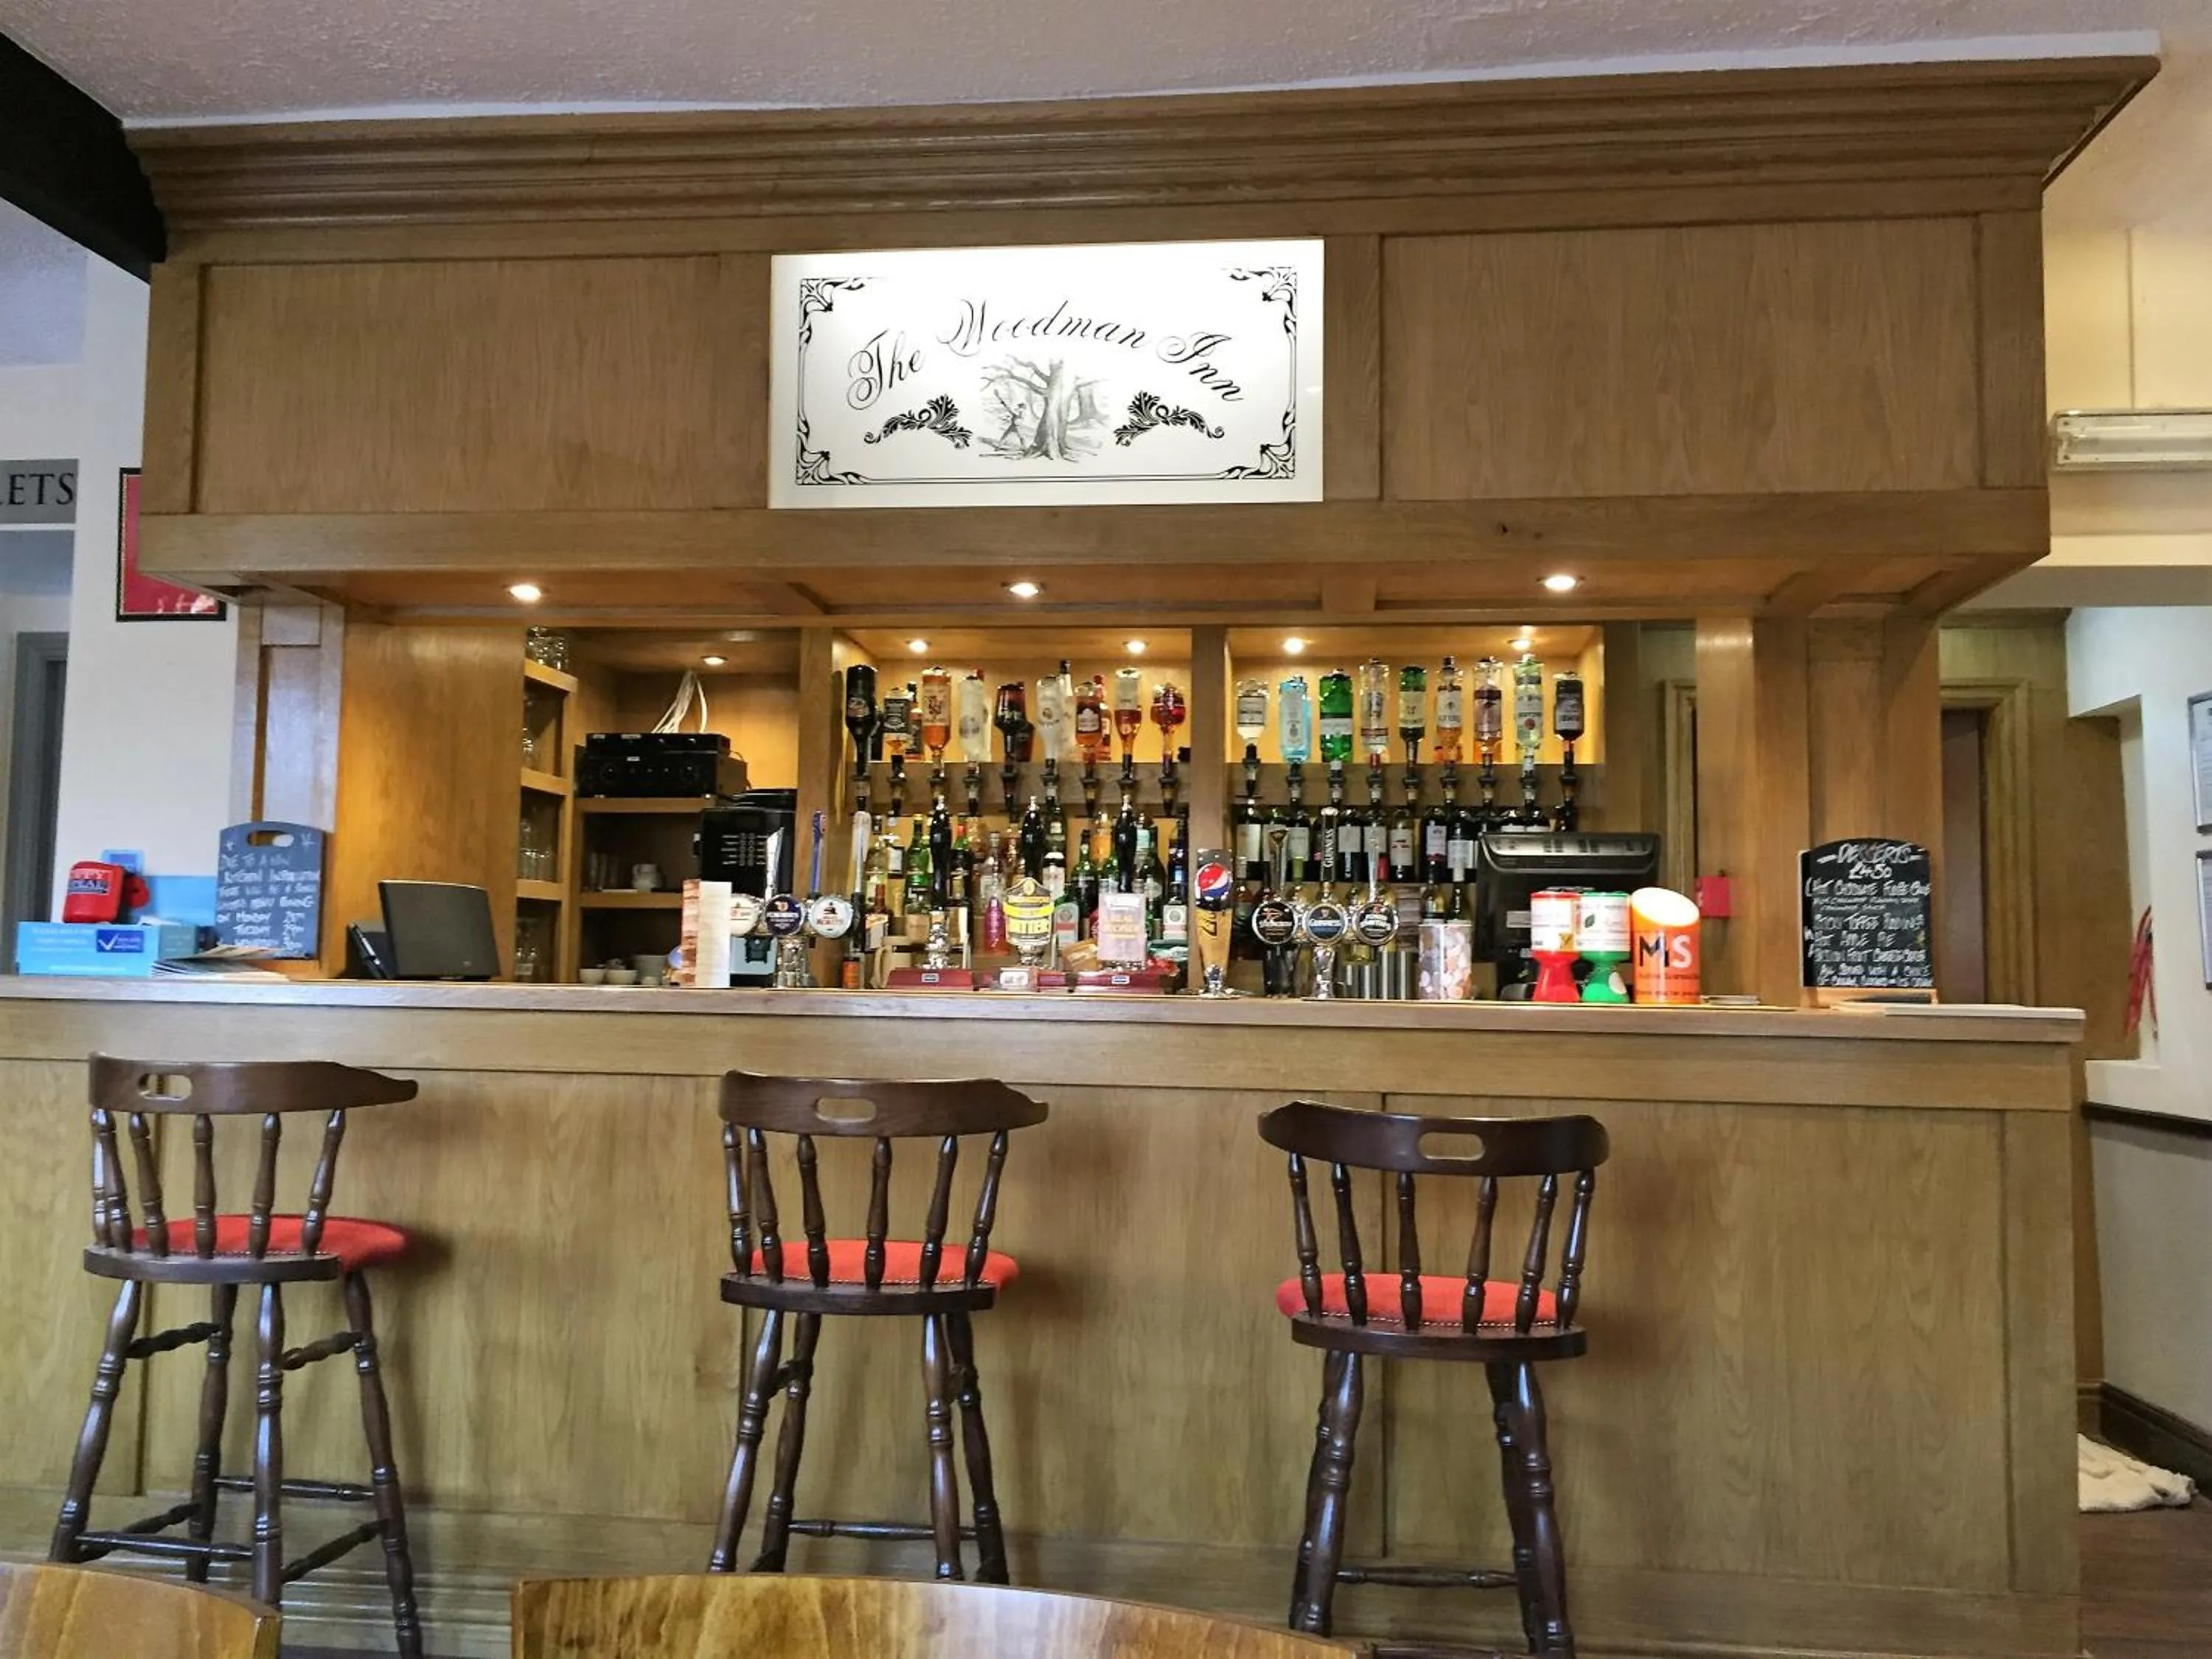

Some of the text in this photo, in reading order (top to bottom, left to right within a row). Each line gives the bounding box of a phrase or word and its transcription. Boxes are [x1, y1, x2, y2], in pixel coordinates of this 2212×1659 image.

[847, 329, 923, 410] The
[1157, 332, 1245, 403] Inn
[0, 472, 74, 506] ETS
